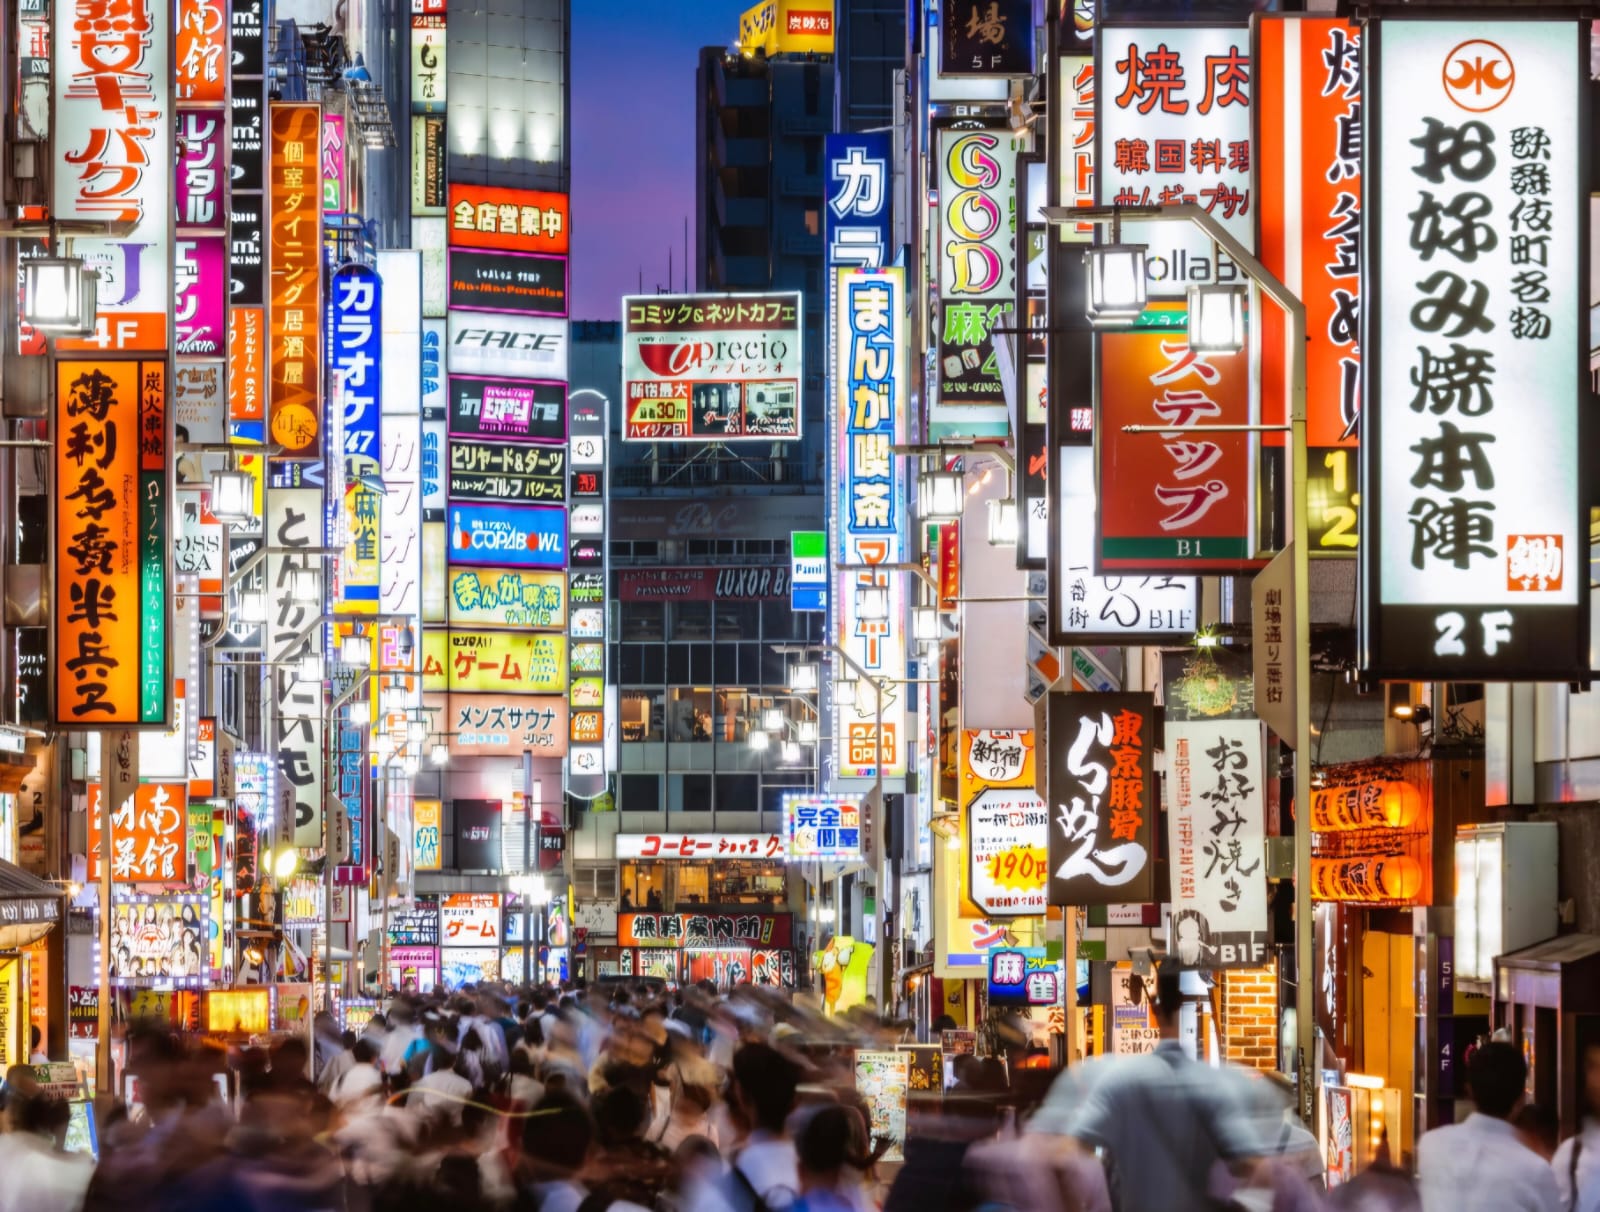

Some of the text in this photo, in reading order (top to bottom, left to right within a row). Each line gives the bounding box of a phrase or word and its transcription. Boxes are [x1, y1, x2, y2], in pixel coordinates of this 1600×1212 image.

[1115, 139, 1249, 174] 韓国料理
[454, 201, 562, 238] 全店営業中
[283, 141, 305, 385] 個室ダイニング居酒屋
[338, 276, 375, 426] カラオケ
[1150, 339, 1228, 531] ステップ
[452, 446, 563, 475] ビリヤード&ダーツ
[1177, 539, 1202, 557] B1
[453, 573, 561, 611] まんが喫茶
[715, 568, 769, 597] LUXOR
[1264, 588, 1283, 704] 劇場通り一番街
[1434, 610, 1514, 656] 2F
[454, 651, 523, 680] ゲーム
[458, 706, 556, 731] メンズサウナ
[641, 836, 712, 857] コーヒー
[447, 919, 496, 938] ゲーム
[1221, 944, 1265, 962] B1F
